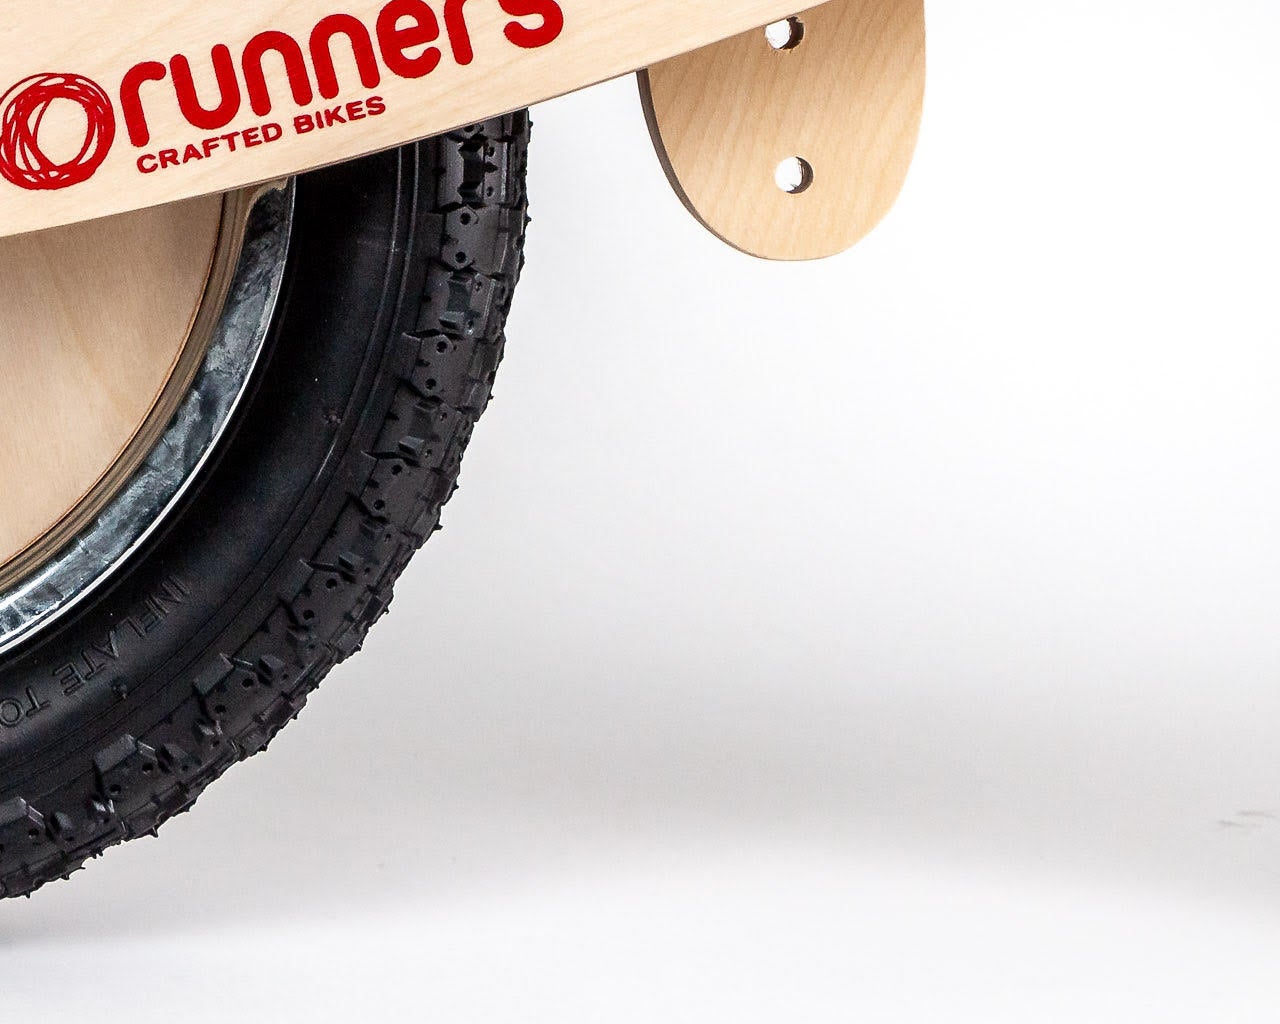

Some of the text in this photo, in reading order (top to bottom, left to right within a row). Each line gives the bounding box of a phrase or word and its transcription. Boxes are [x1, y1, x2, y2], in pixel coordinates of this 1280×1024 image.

[136, 96, 386, 174] CRAFTED BIKES
[51, 574, 190, 696] INFLATE
